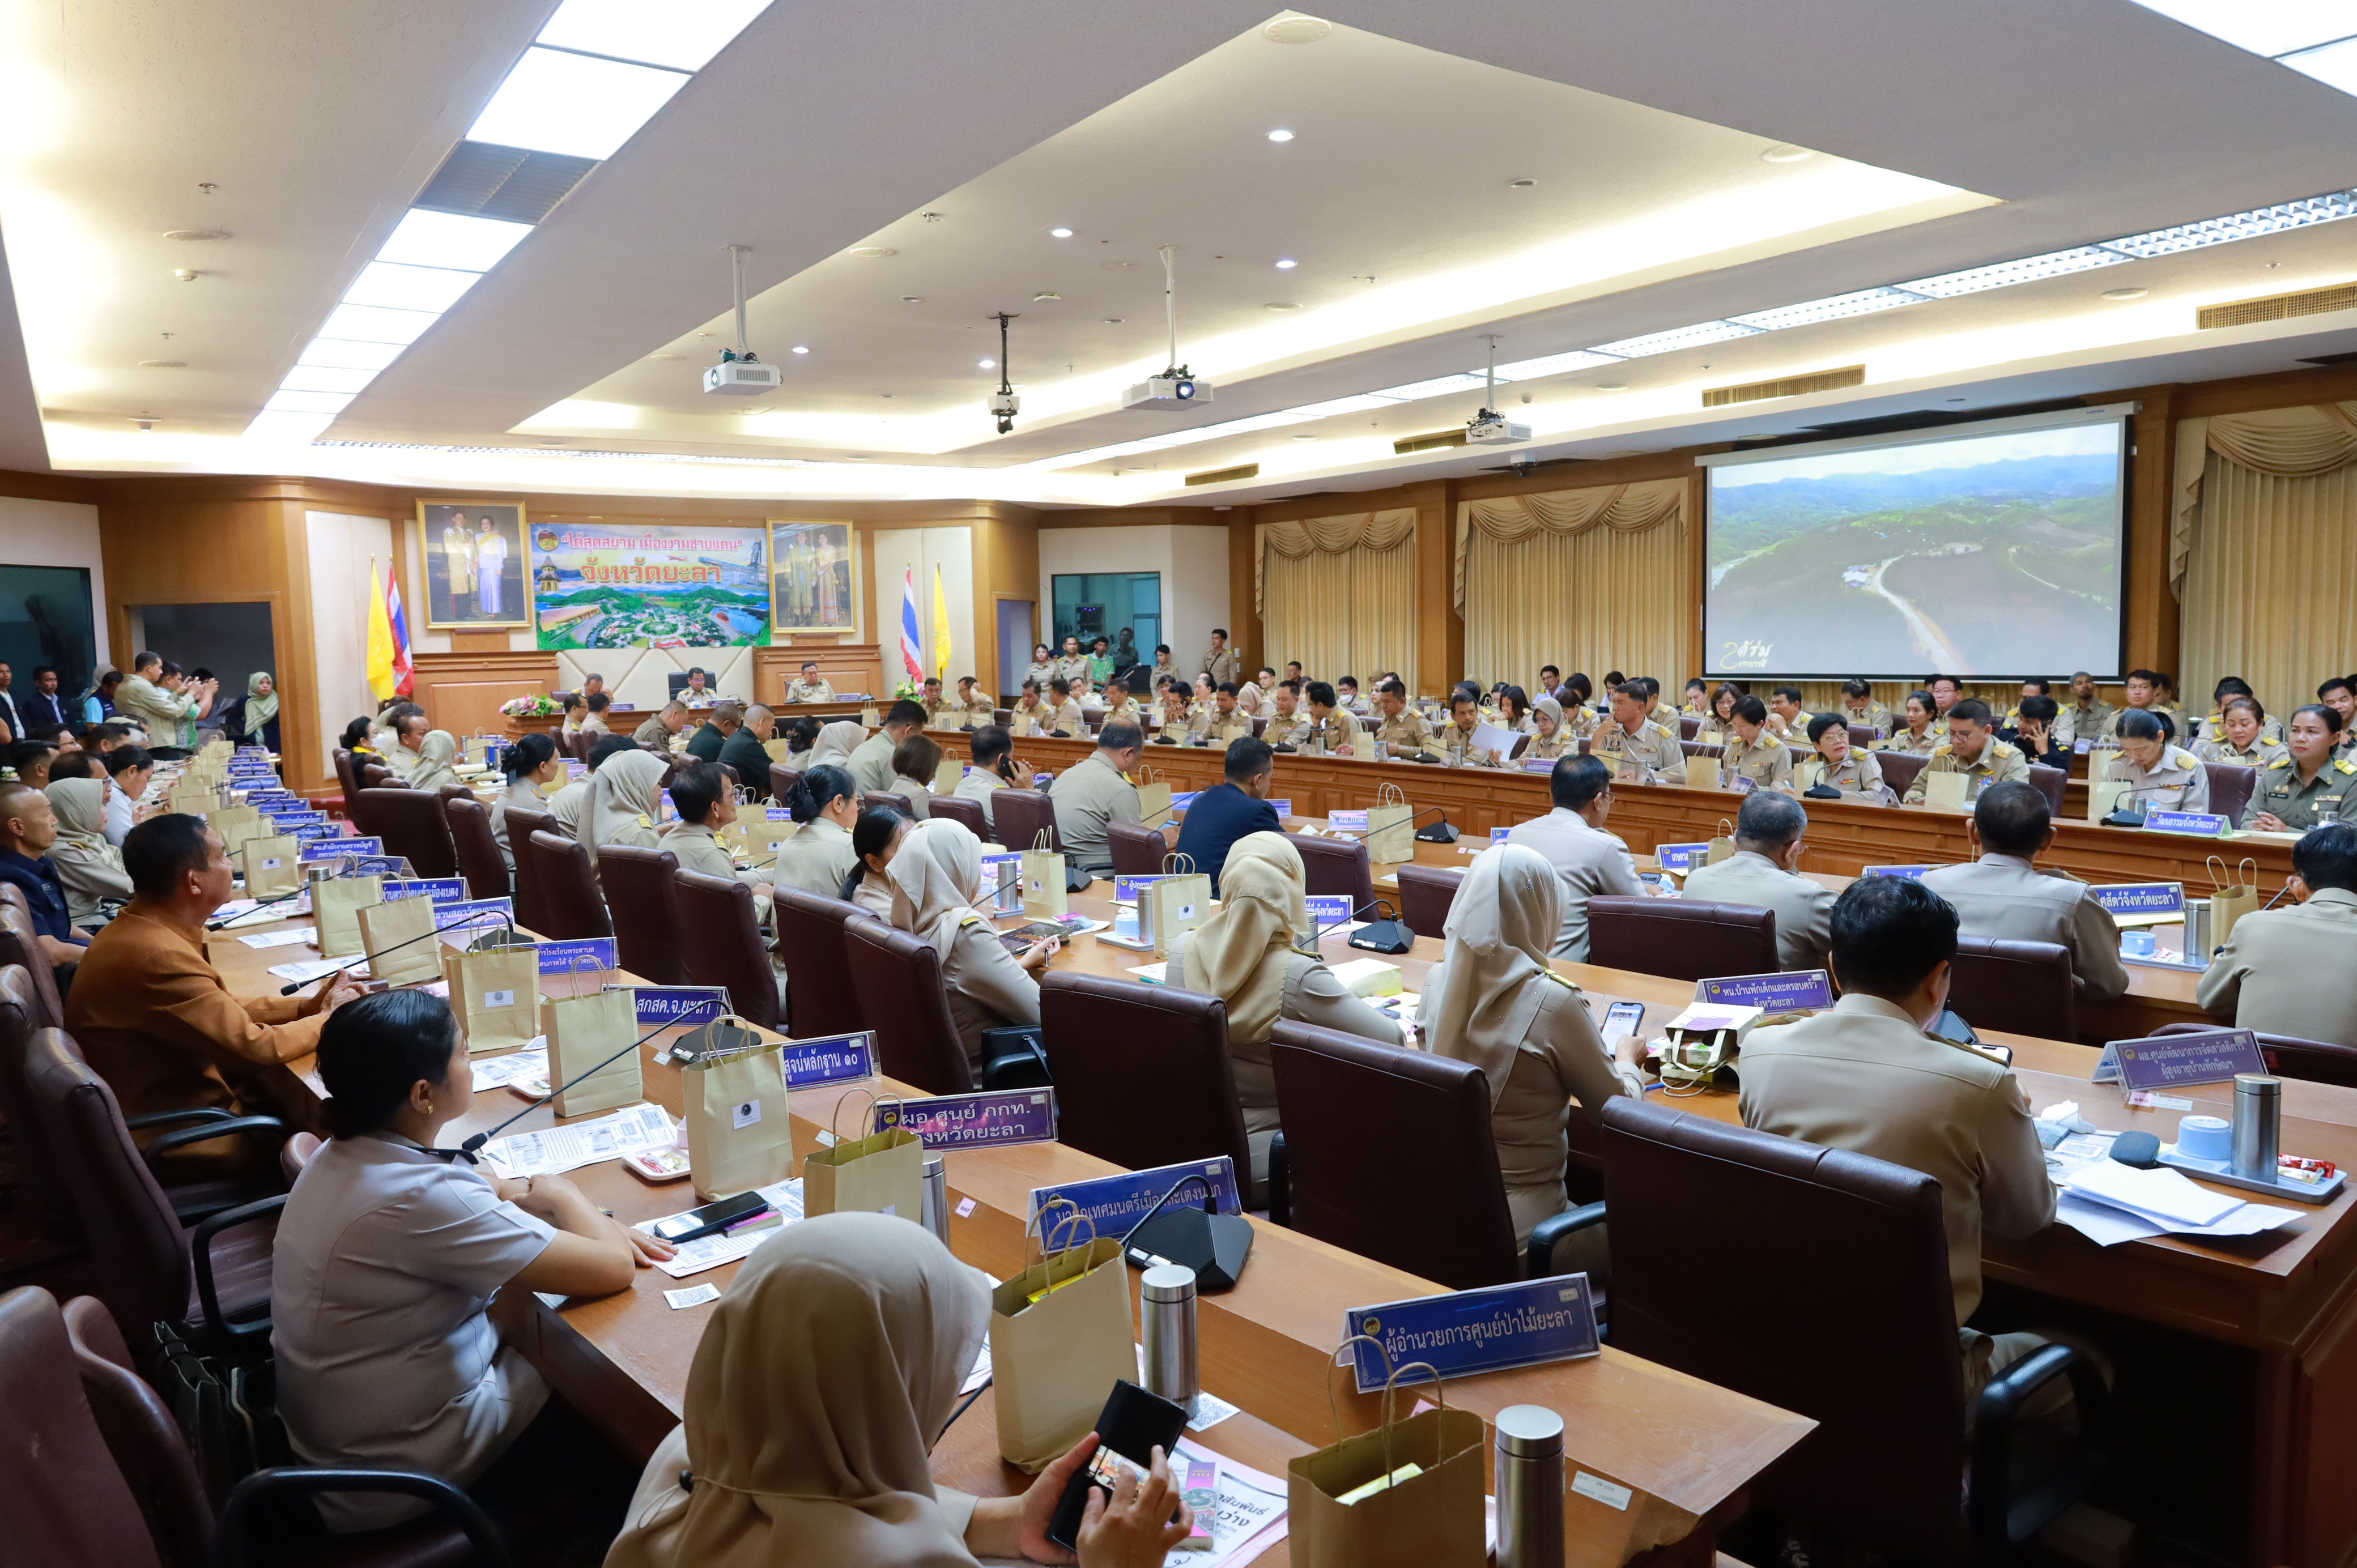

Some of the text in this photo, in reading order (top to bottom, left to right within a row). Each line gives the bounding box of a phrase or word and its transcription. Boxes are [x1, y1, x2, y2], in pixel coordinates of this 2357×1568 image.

[580, 556, 722, 583] จังหวัดยะลา
[2156, 814, 2218, 829] วัฒนธรรมจังหวัดยะลา
[313, 841, 373, 850] หน.สำนักงานตรวจบัญชี
[1722, 978, 1818, 996] หน.บ้านพักเด็กและครอบครัว
[1754, 996, 1795, 1008] จังหวัดยะลา
[844, 1054, 858, 1066] ๑๐
[2138, 1041, 2245, 1064] ผอ.ศูนย์พัฒนาการจัดสวัสดิการ
[2161, 1059, 2234, 1080] ผู้สูงอายุบ้านทักษิณฯ
[902, 1102, 1031, 1127] ผอ.ศูนย์ กกท.
[1056, 1184, 1221, 1223] นากเทศมนตรีเมือะเตงนก
[1386, 1307, 1573, 1362] ผู้อำนวยการศูนย์ป่าไม้ยะลา
